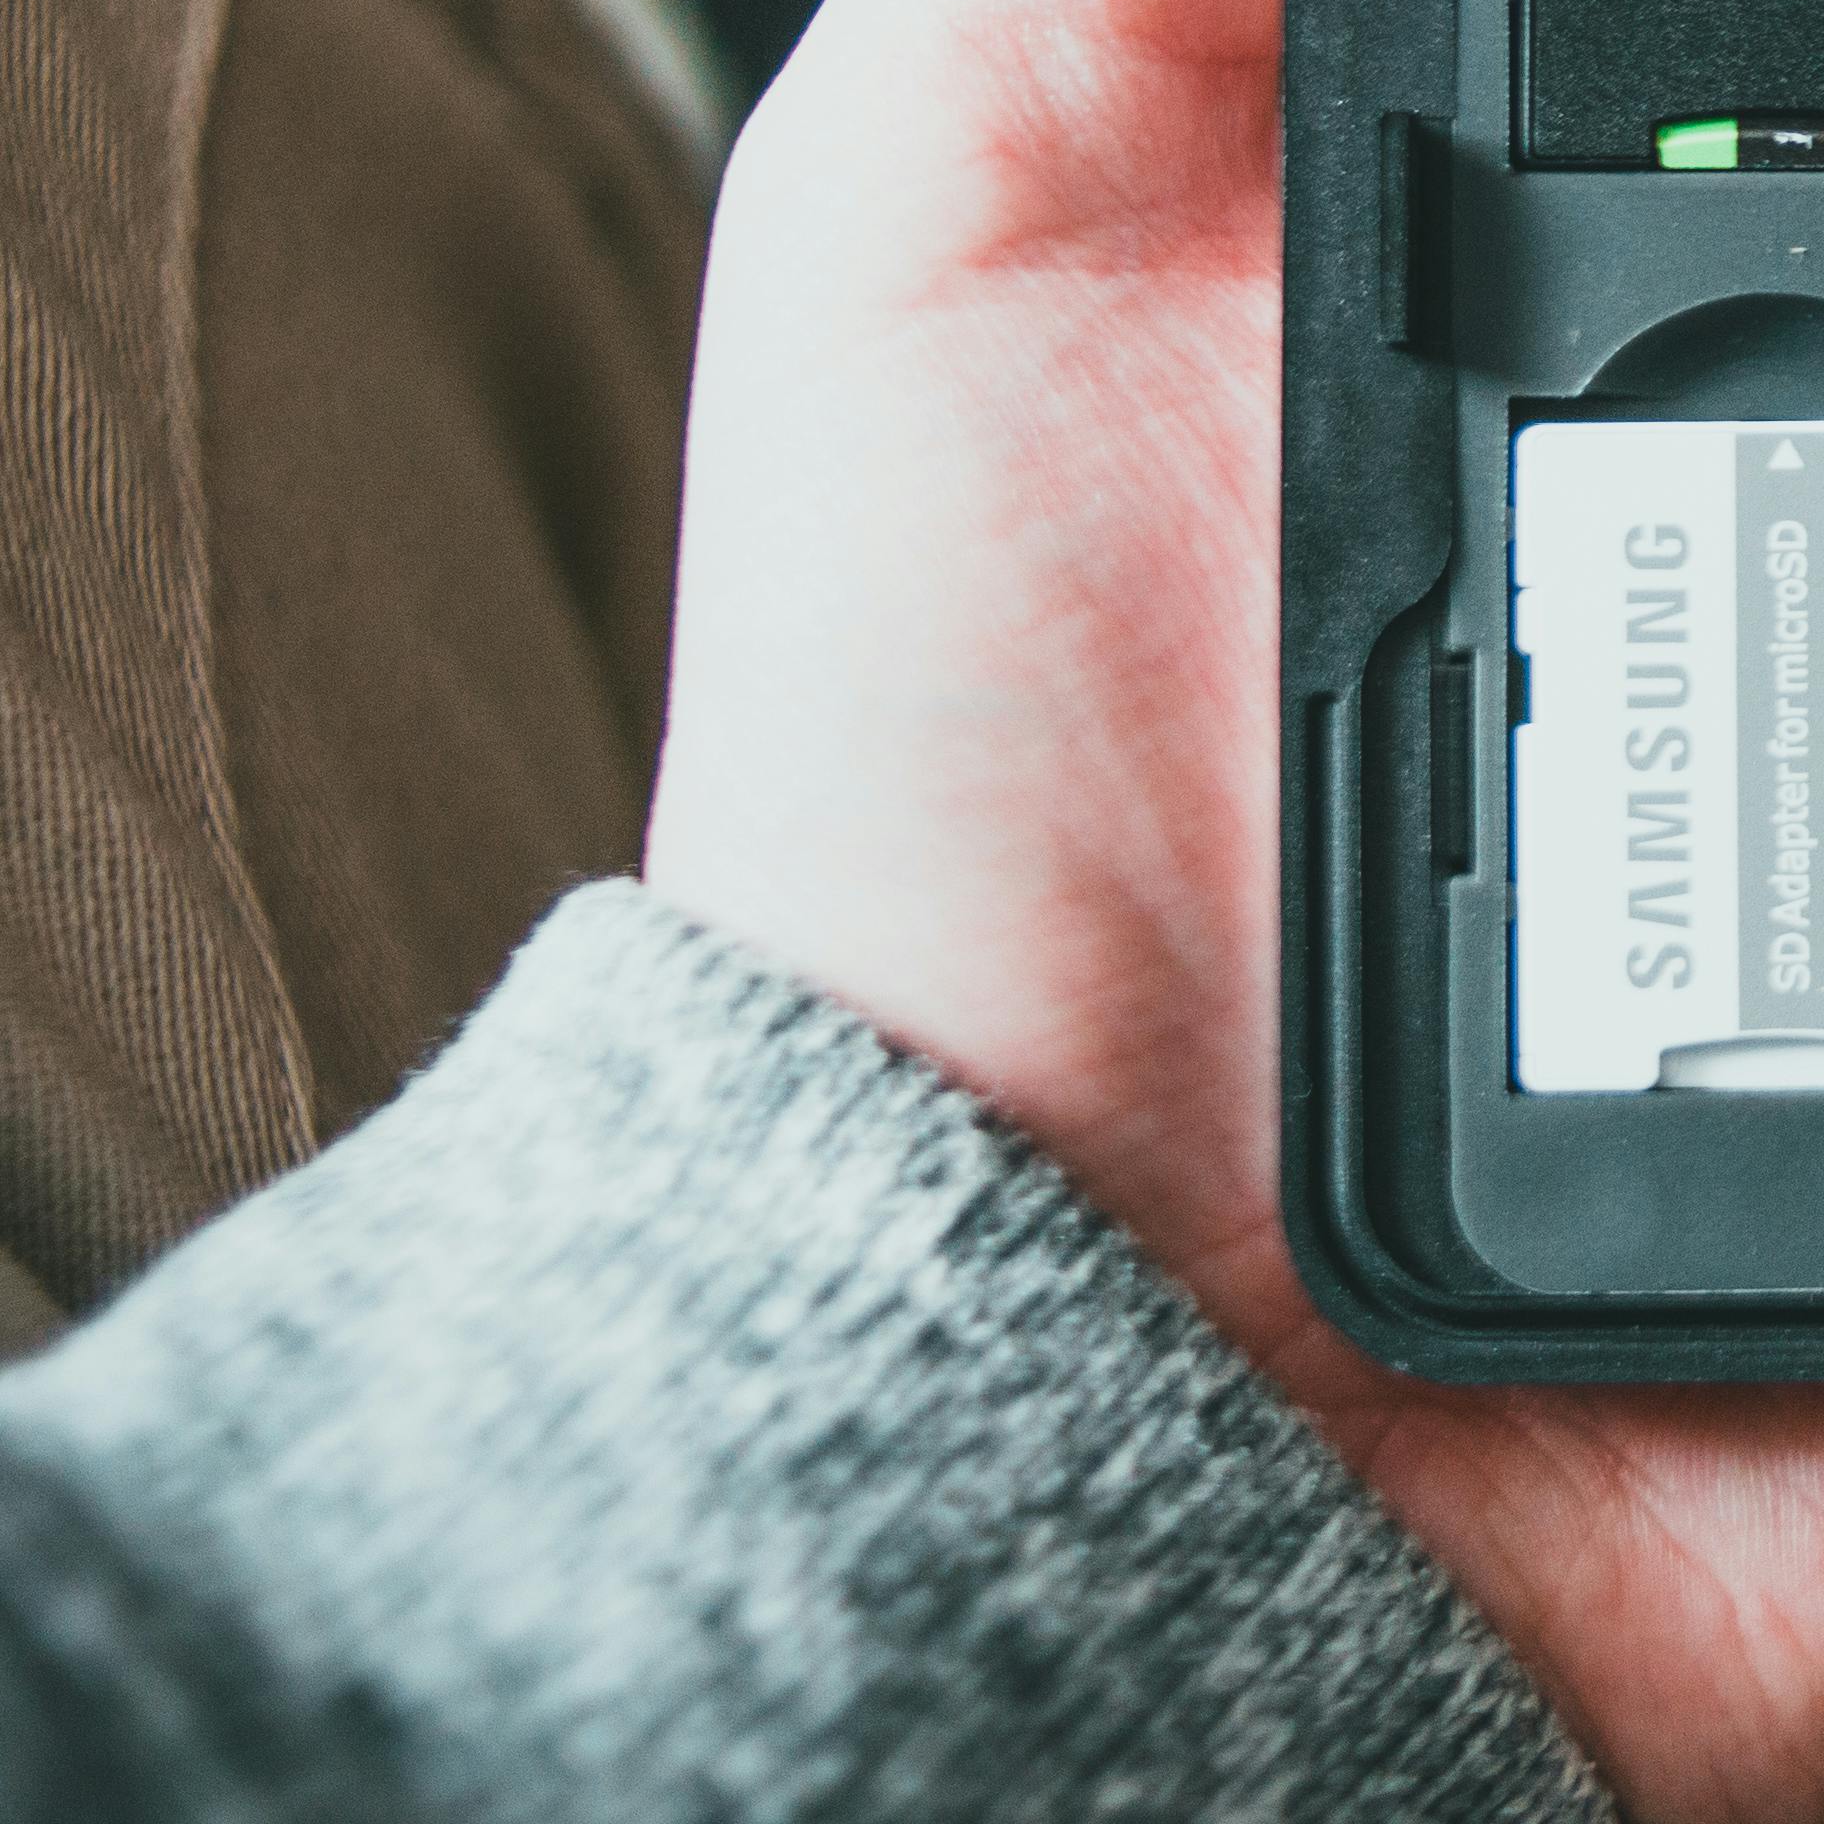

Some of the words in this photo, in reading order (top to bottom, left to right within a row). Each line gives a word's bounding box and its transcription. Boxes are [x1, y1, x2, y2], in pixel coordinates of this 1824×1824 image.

[1766, 519, 1809, 693] microSD
[1624, 521, 1694, 991] SAMSUNG
[1765, 696, 1809, 758] for
[1768, 762, 1819, 927] Adapter
[1768, 932, 1811, 993] SD
